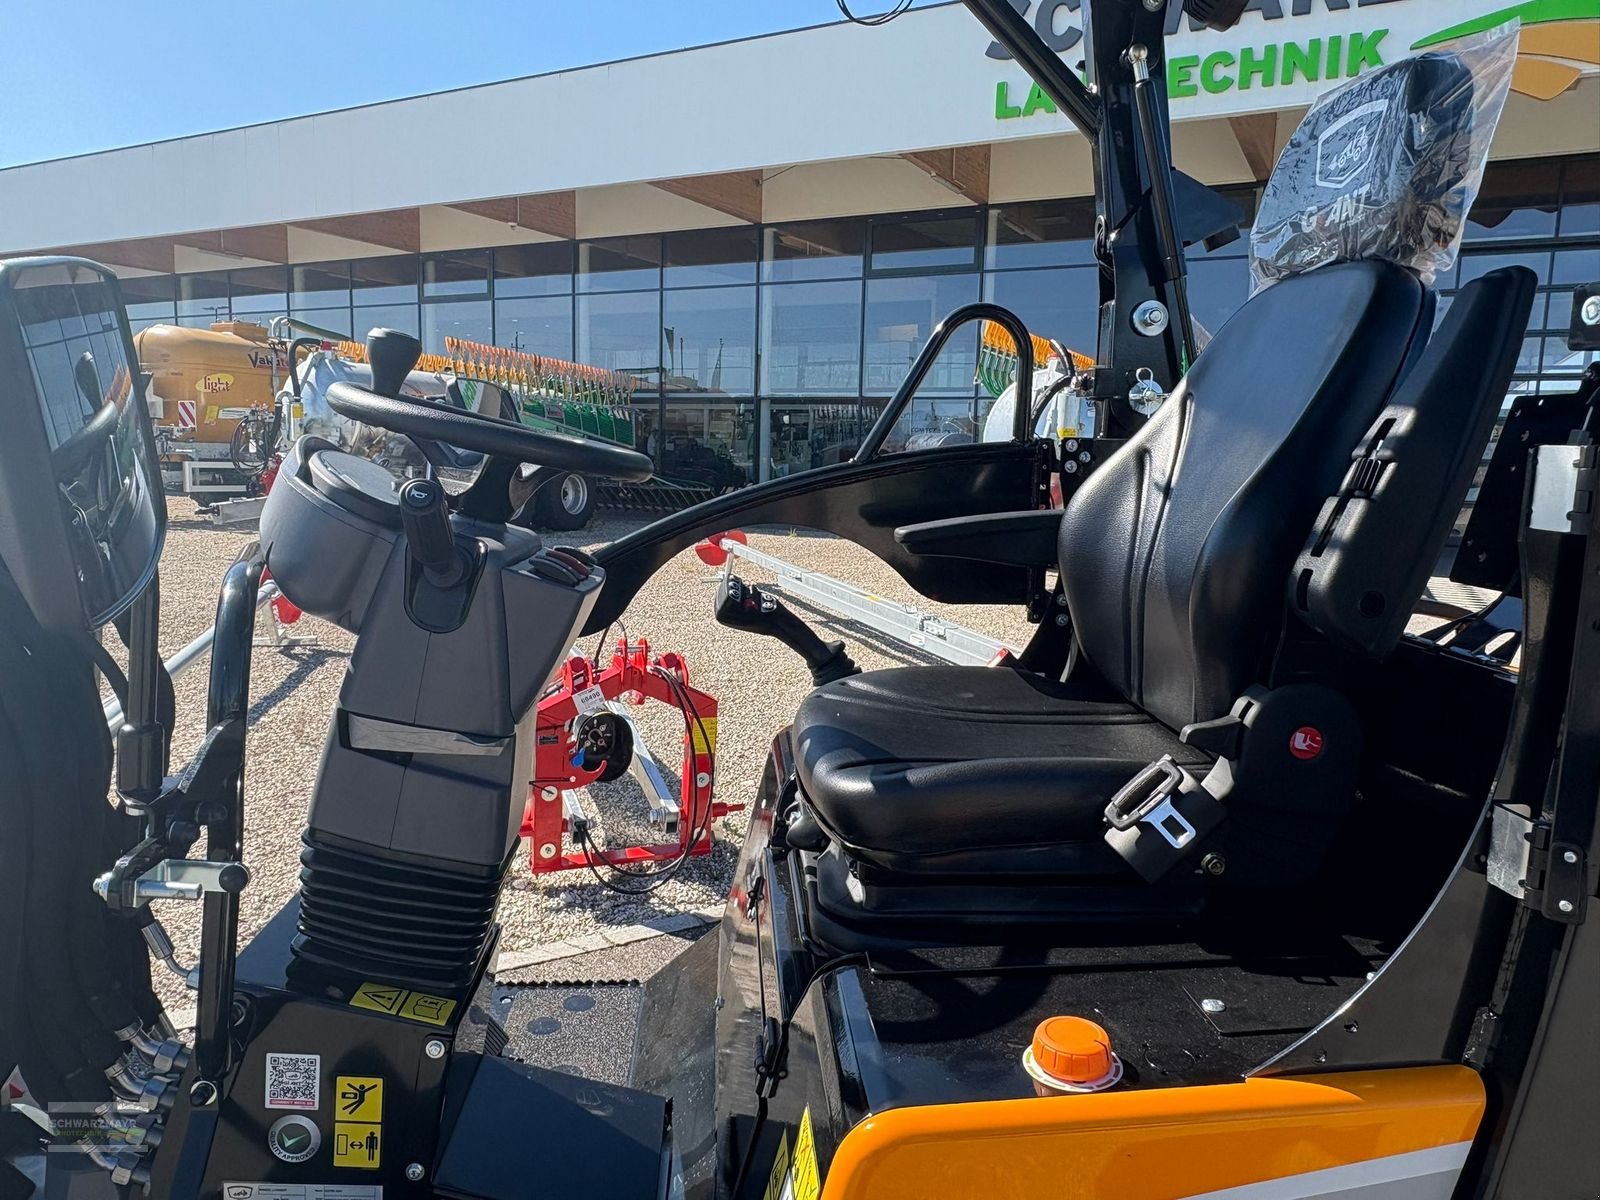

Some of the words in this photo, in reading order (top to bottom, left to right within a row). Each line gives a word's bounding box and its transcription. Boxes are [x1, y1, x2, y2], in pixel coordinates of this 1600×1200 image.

[995, 28, 1389, 119] LAECHNIK
[1301, 183, 1371, 233] GANT
[204, 376, 230, 393] light
